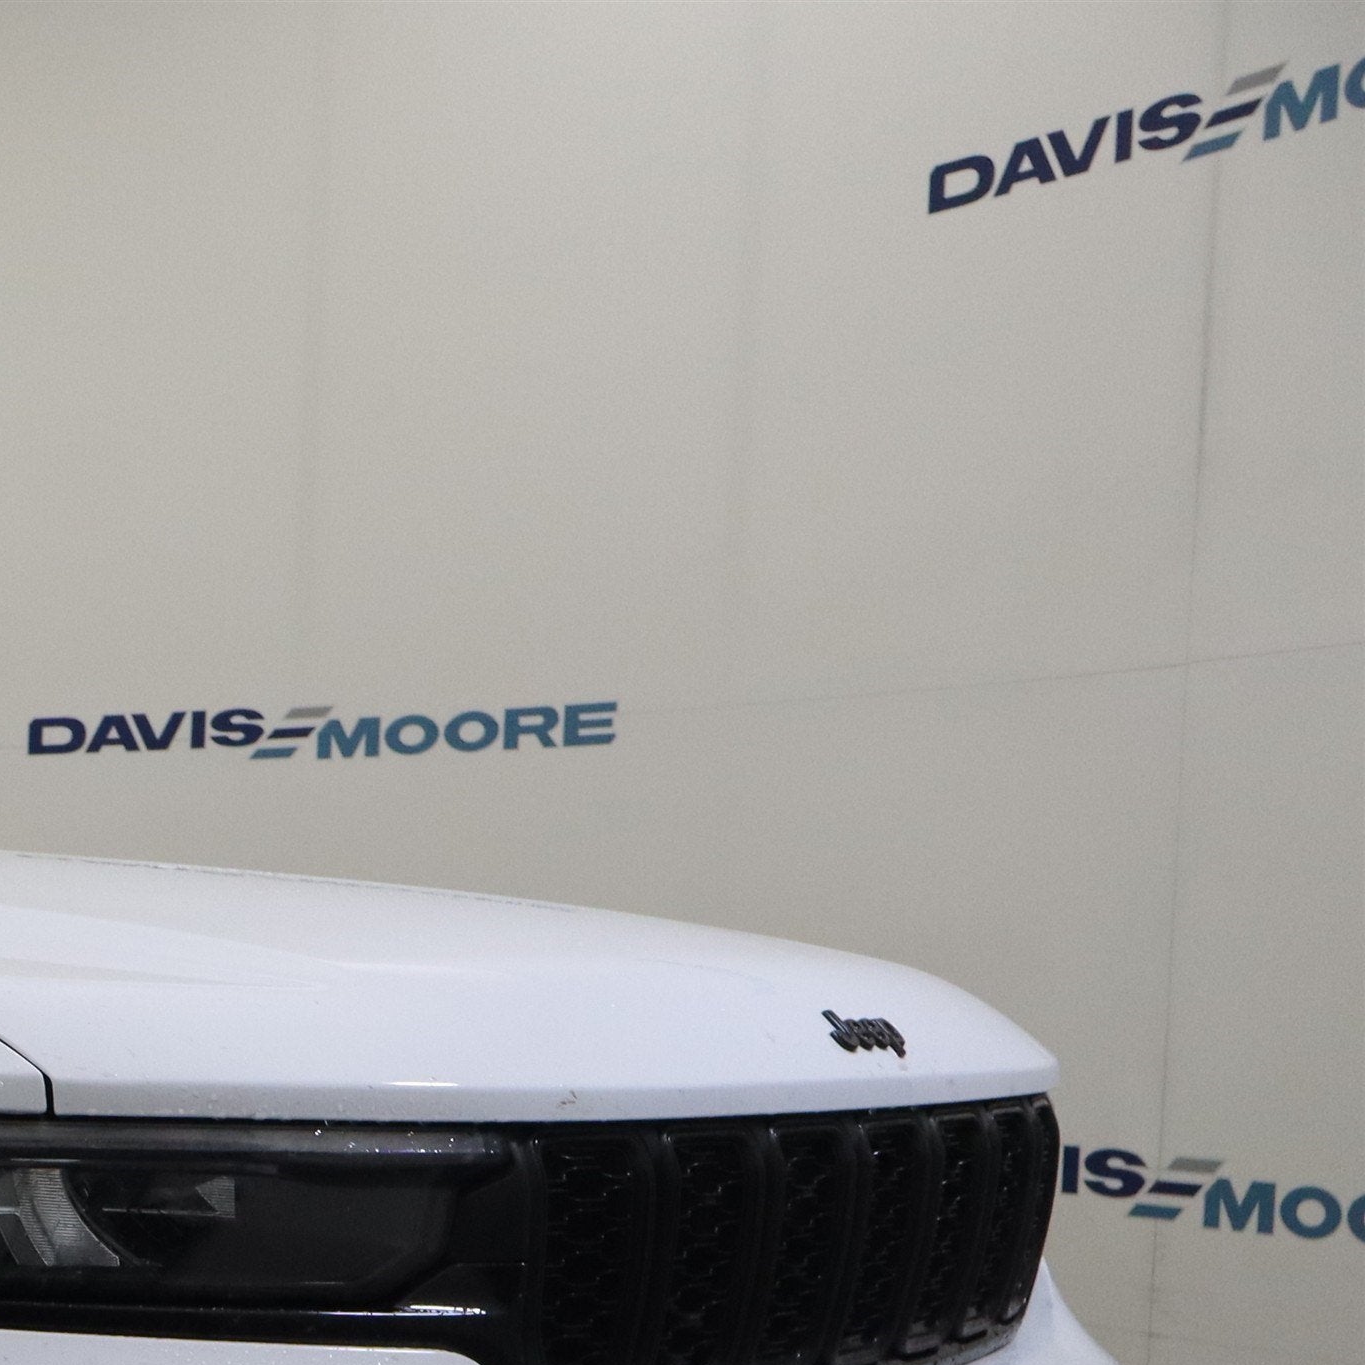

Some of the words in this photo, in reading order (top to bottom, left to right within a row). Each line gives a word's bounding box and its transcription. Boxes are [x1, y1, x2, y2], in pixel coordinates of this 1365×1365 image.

[928, 93, 1203, 215] DAVIS
[26, 708, 265, 756] DAVIS
[317, 702, 618, 759] MOORE
[821, 1009, 906, 1059] Jeep
[1202, 1178, 1365, 1243] MO
